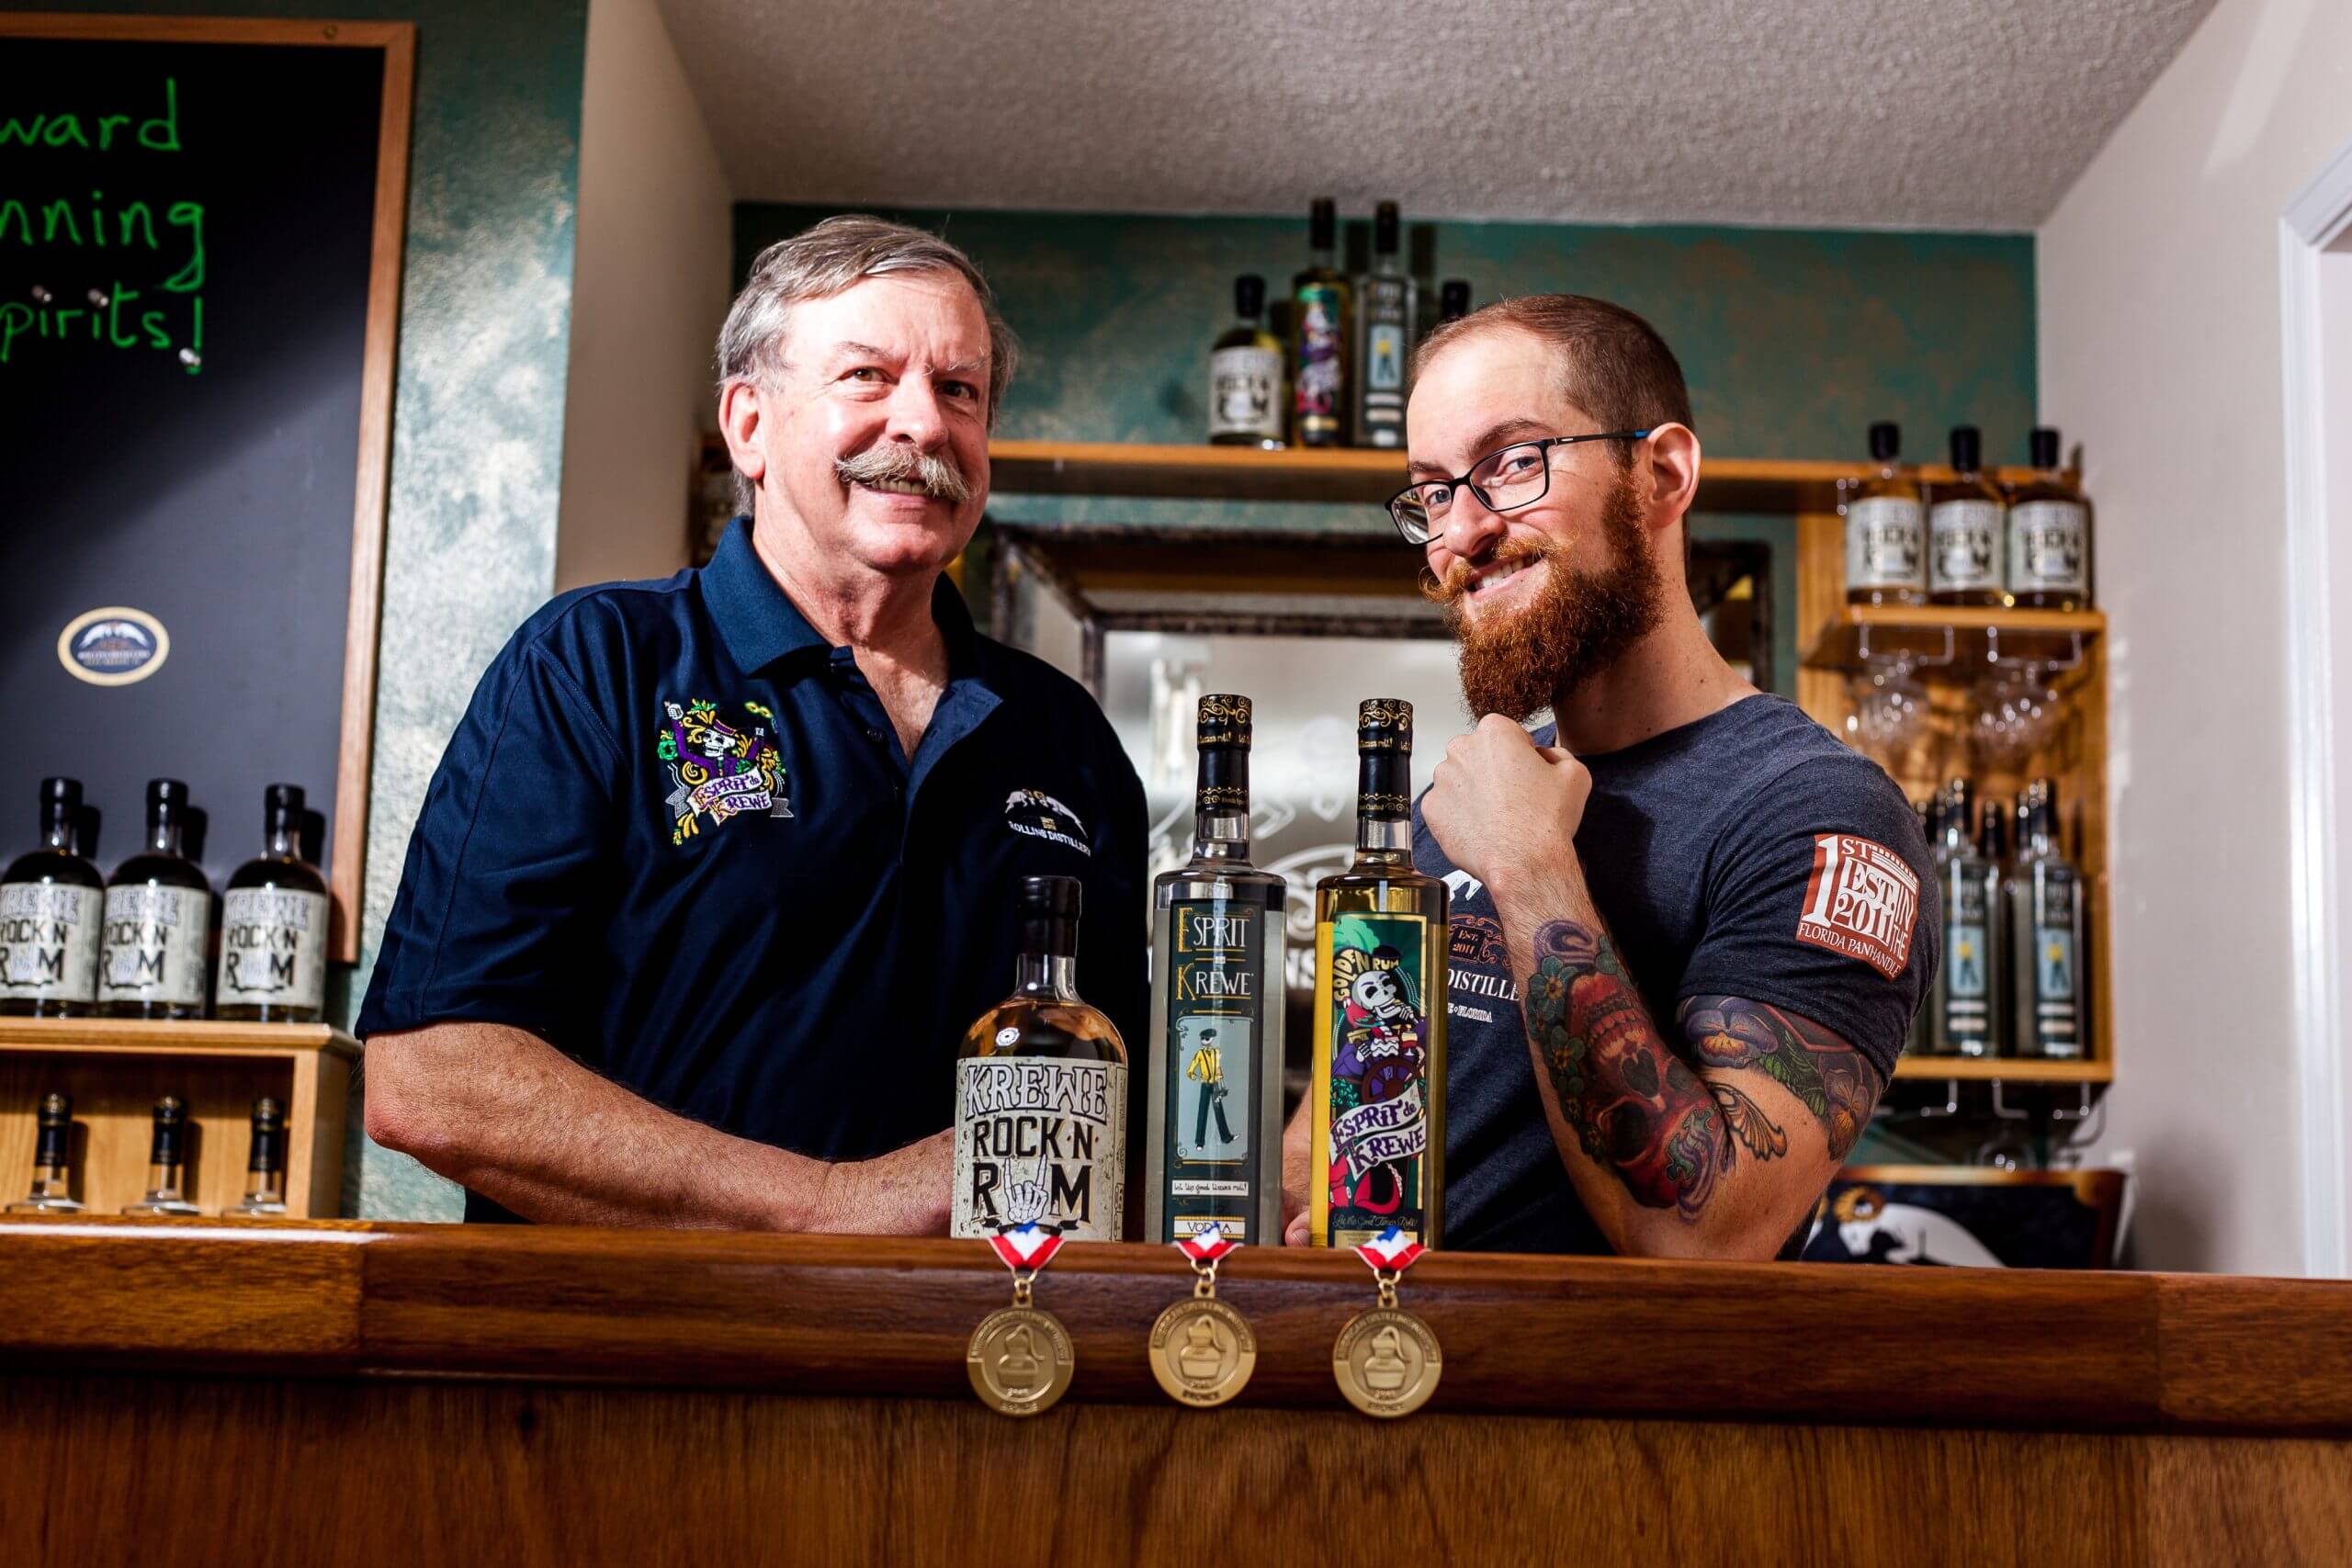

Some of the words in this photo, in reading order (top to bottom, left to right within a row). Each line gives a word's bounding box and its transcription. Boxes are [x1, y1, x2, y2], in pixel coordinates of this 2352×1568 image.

[707, 793, 770, 823] KREWE
[1836, 891, 1894, 947] 2011
[1895, 885, 1914, 931] IN
[1178, 906, 1250, 953] ESPRIT
[1453, 942, 1476, 954] 2011
[1798, 922, 1845, 950] FLORIDA
[1848, 938, 1902, 979] PANHANDLE
[1890, 922, 1908, 961] THE
[1176, 963, 1251, 1001] KREWE
[1372, 957, 1399, 972] RUM
[966, 1064, 1108, 1126] KREWE
[1345, 1125, 1425, 1176] KREWE
[1188, 1222, 1232, 1234] VODA
